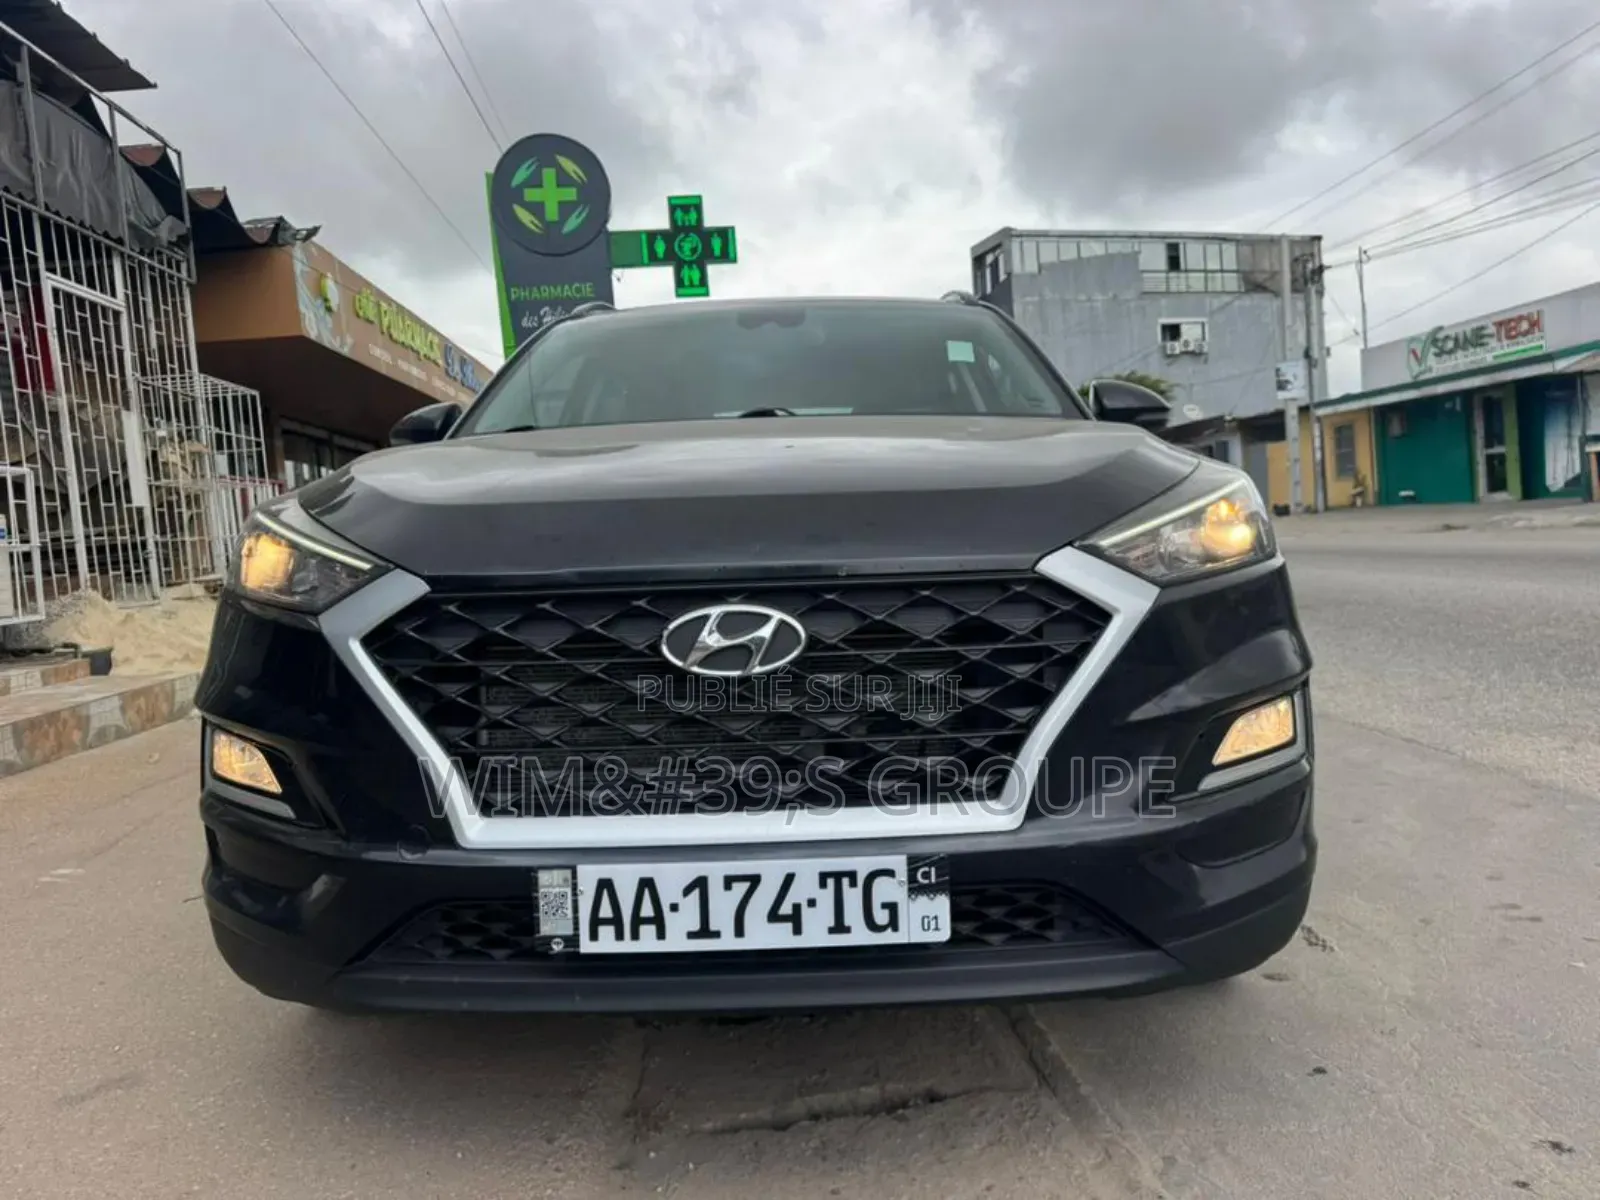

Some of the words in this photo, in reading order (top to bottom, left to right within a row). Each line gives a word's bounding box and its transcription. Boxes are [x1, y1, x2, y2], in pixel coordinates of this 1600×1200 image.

[510, 282, 595, 300] PHARMACIE
[916, 867, 936, 884] CI
[920, 914, 942, 932] 01
